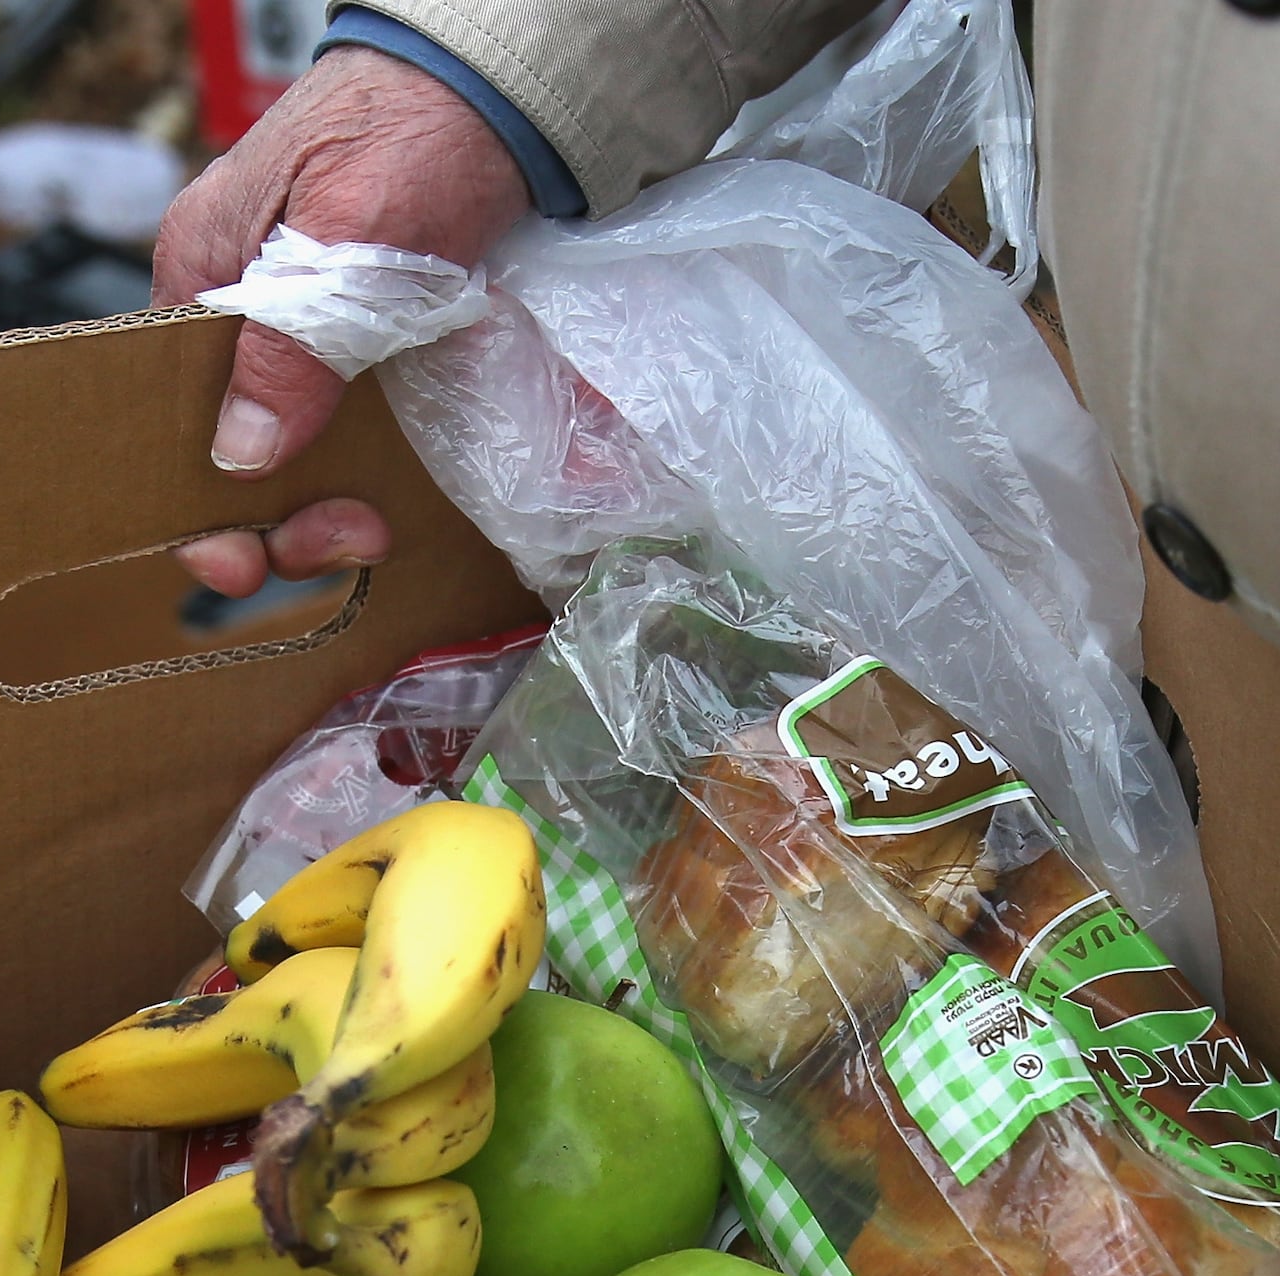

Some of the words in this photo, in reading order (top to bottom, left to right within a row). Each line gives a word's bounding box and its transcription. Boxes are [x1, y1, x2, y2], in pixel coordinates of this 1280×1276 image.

[1034, 912, 1140, 1014] QUALIT
[941, 985, 979, 1016] YOSHON
[965, 1002, 1007, 1028] Rockaway
[976, 1006, 1048, 1058] VAAD
